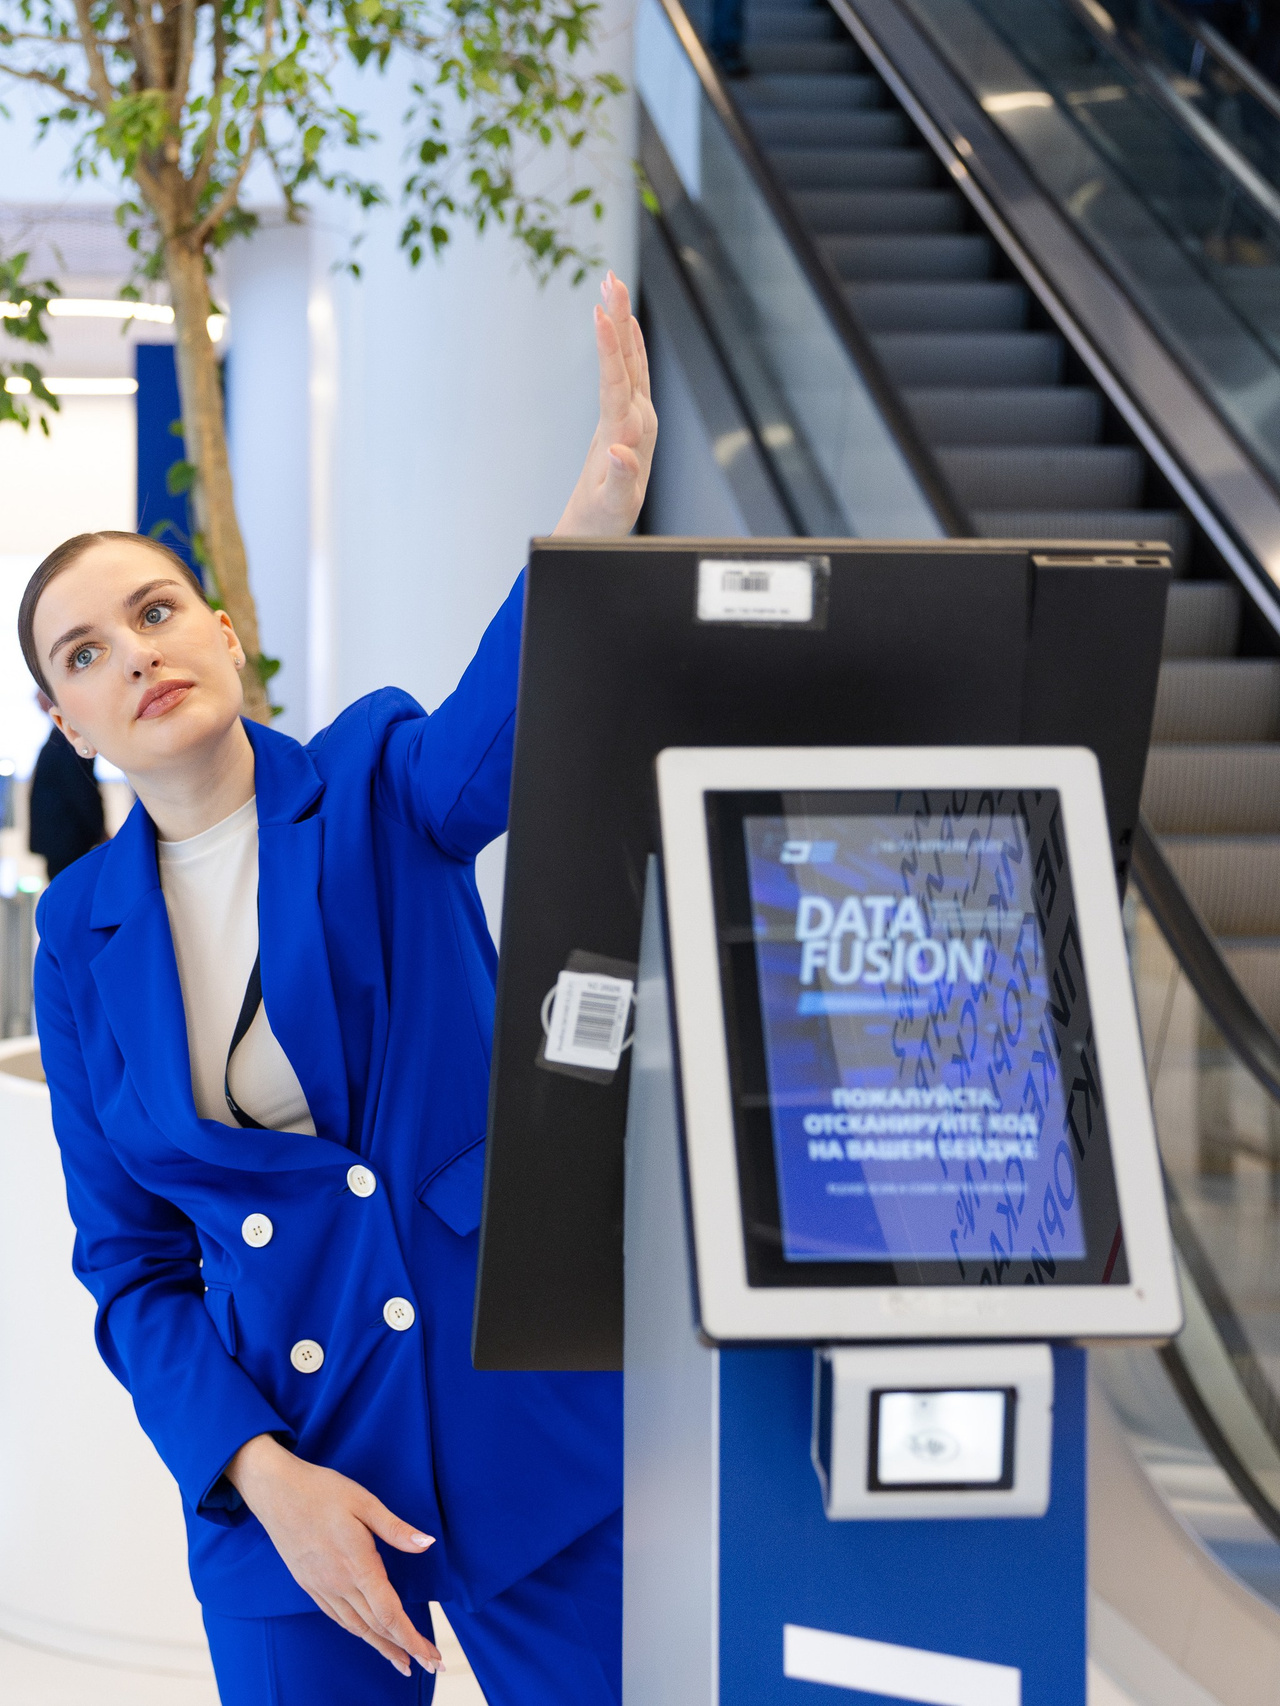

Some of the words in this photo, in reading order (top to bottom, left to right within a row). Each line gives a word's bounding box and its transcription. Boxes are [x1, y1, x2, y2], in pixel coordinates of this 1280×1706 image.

[795, 895, 927, 941] DATA
[799, 937, 987, 985] FUSION
[803, 1110, 983, 1135] ОТСКАНИРУЙТЕ
[987, 1112, 1040, 1138] КОД
[808, 1139, 844, 1161] НА
[845, 1138, 936, 1161] ВАШЕМ
